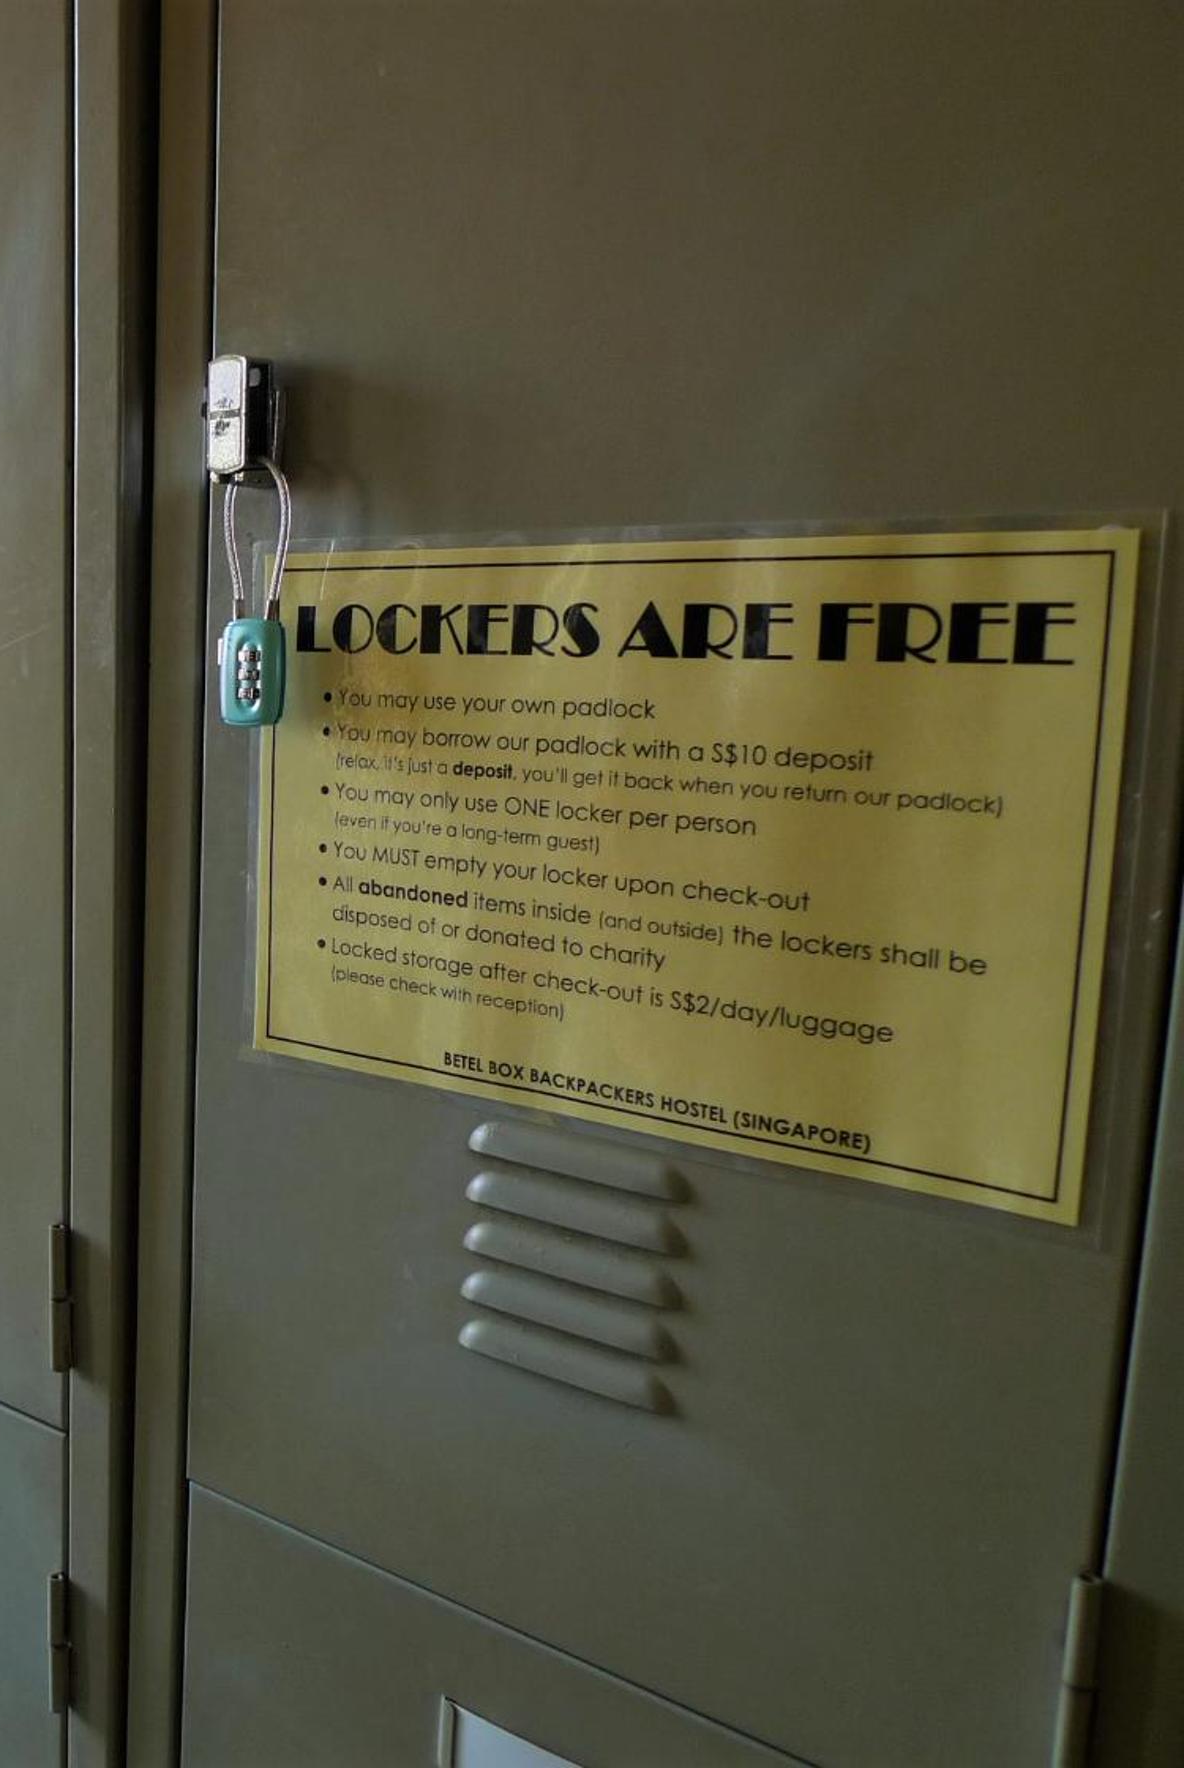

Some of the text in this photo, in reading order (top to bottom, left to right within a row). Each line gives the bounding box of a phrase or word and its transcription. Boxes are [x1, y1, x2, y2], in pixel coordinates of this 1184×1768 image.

[295, 600, 1077, 666] LOCKERS ARE FREE
[337, 690, 657, 721] You may use your own padlock
[336, 725, 875, 774] You may borrow our padlock with a S$10 deposit
[334, 781, 757, 836] You may only use ONE locker per person
[406, 755, 434, 777] just
[436, 761, 449, 775] a
[521, 765, 568, 786] you'll
[571, 768, 604, 790] get
[608, 768, 619, 787] it
[623, 768, 674, 792] back
[679, 775, 734, 797] when
[739, 781, 779, 803] you
[783, 782, 848, 805] return
[854, 787, 892, 808] our
[896, 787, 1004, 819] padlock)
[334, 810, 600, 856] (even if you're a long-term guest)
[333, 839, 812, 913] You MUST empty your locker upon check-out
[331, 903, 667, 974] disposed of or donated to charity
[332, 875, 988, 977] All abandoned items inside (and outside) the lockers shall be
[330, 964, 565, 1022] (please check with reception)
[331, 937, 894, 1045] Locked storage after check-out is S$2/day/luggage
[443, 1050, 872, 1155] BETEL BOX BACKPACKERS HOSTEL (SINGAPORE)
